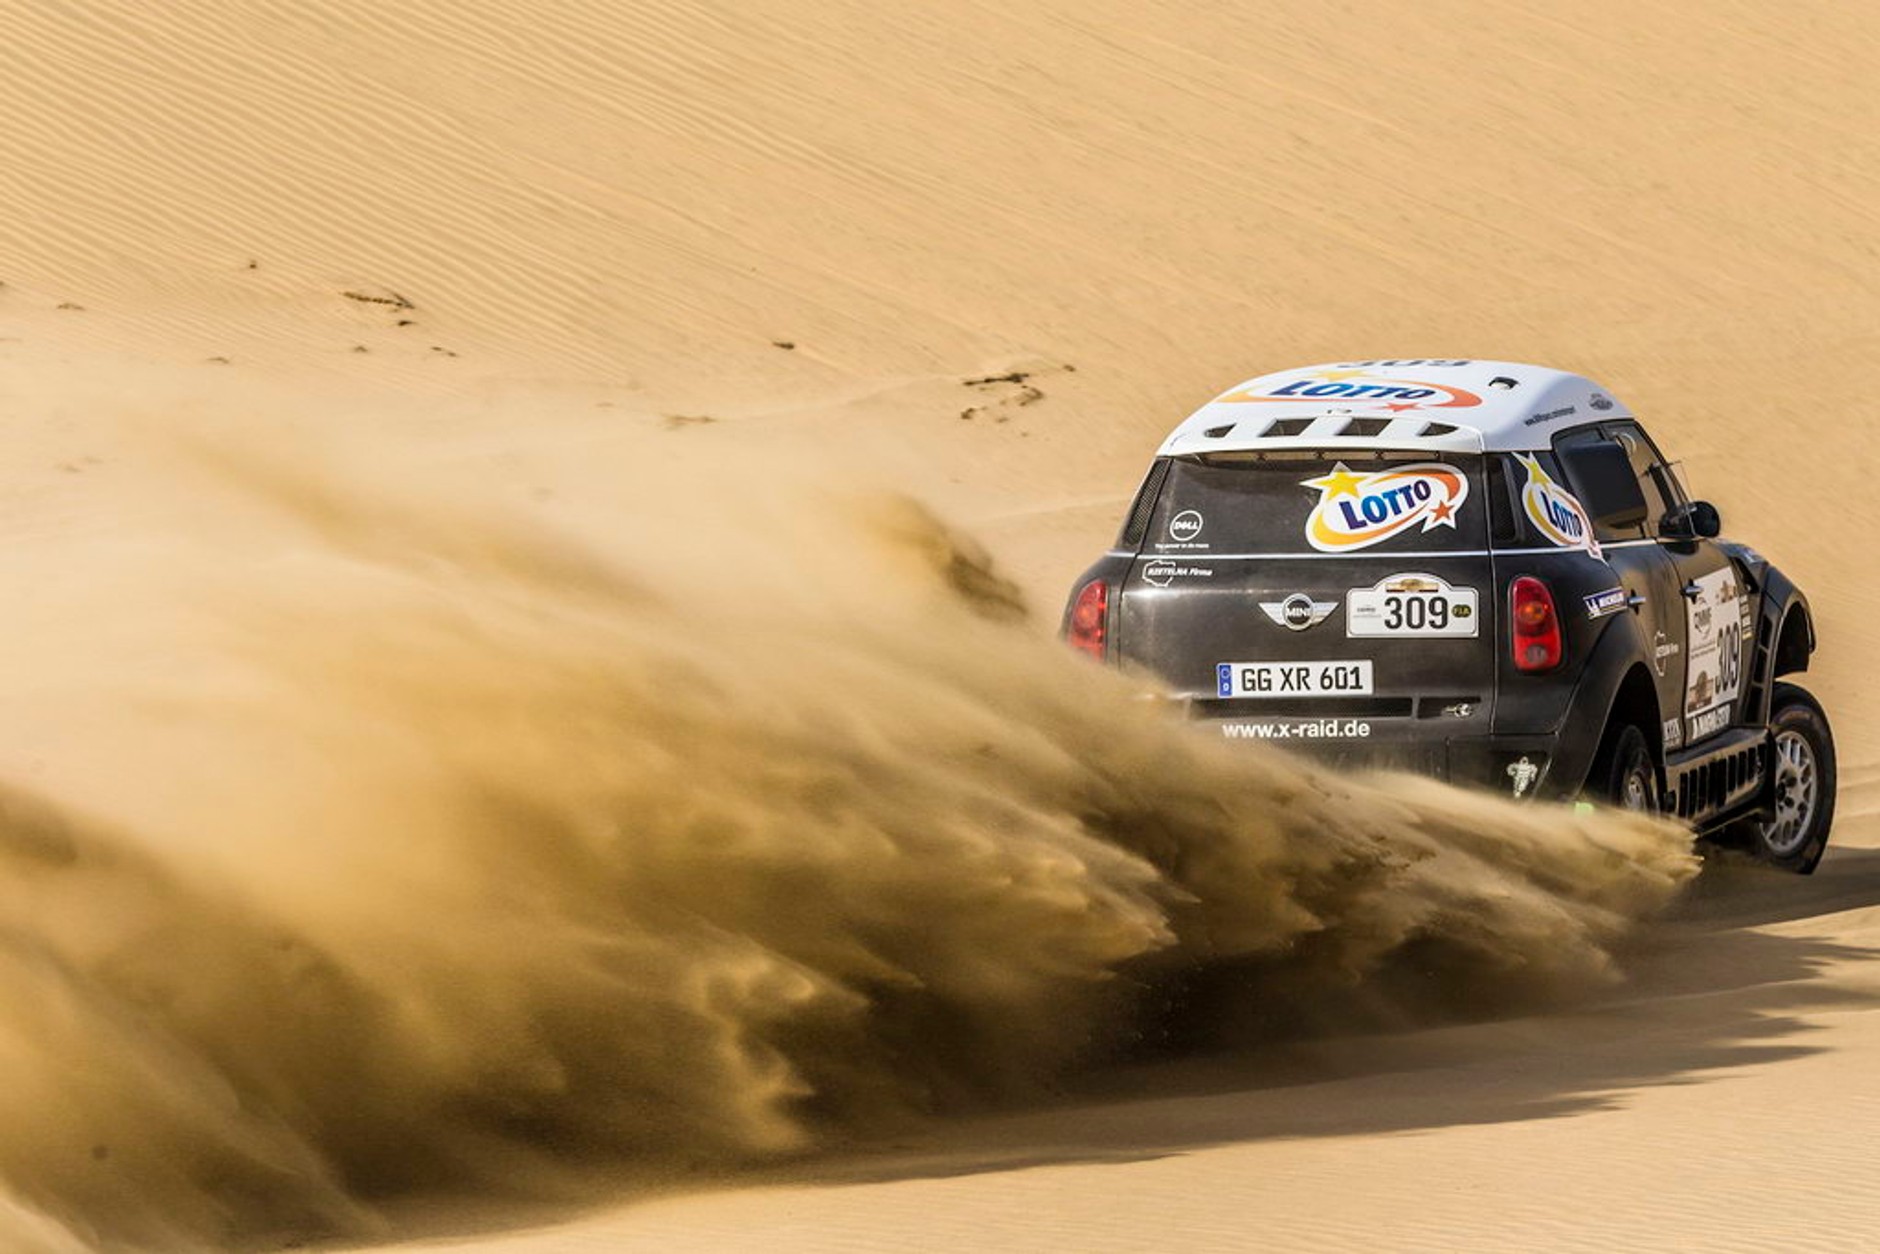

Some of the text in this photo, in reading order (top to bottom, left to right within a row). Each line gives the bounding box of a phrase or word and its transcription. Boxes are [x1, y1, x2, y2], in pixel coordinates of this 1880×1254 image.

[1268, 380, 1436, 400] LOTTO
[1339, 479, 1431, 530] LOTTO
[1540, 490, 1583, 538] LOTTO
[1173, 521, 1199, 530] DELL
[1286, 607, 1310, 617] MINI
[1384, 596, 1448, 630] 309
[1714, 621, 1740, 695] 309
[1241, 666, 1363, 692] GG XR 601
[1222, 719, 1371, 738] www.x-raid.de
